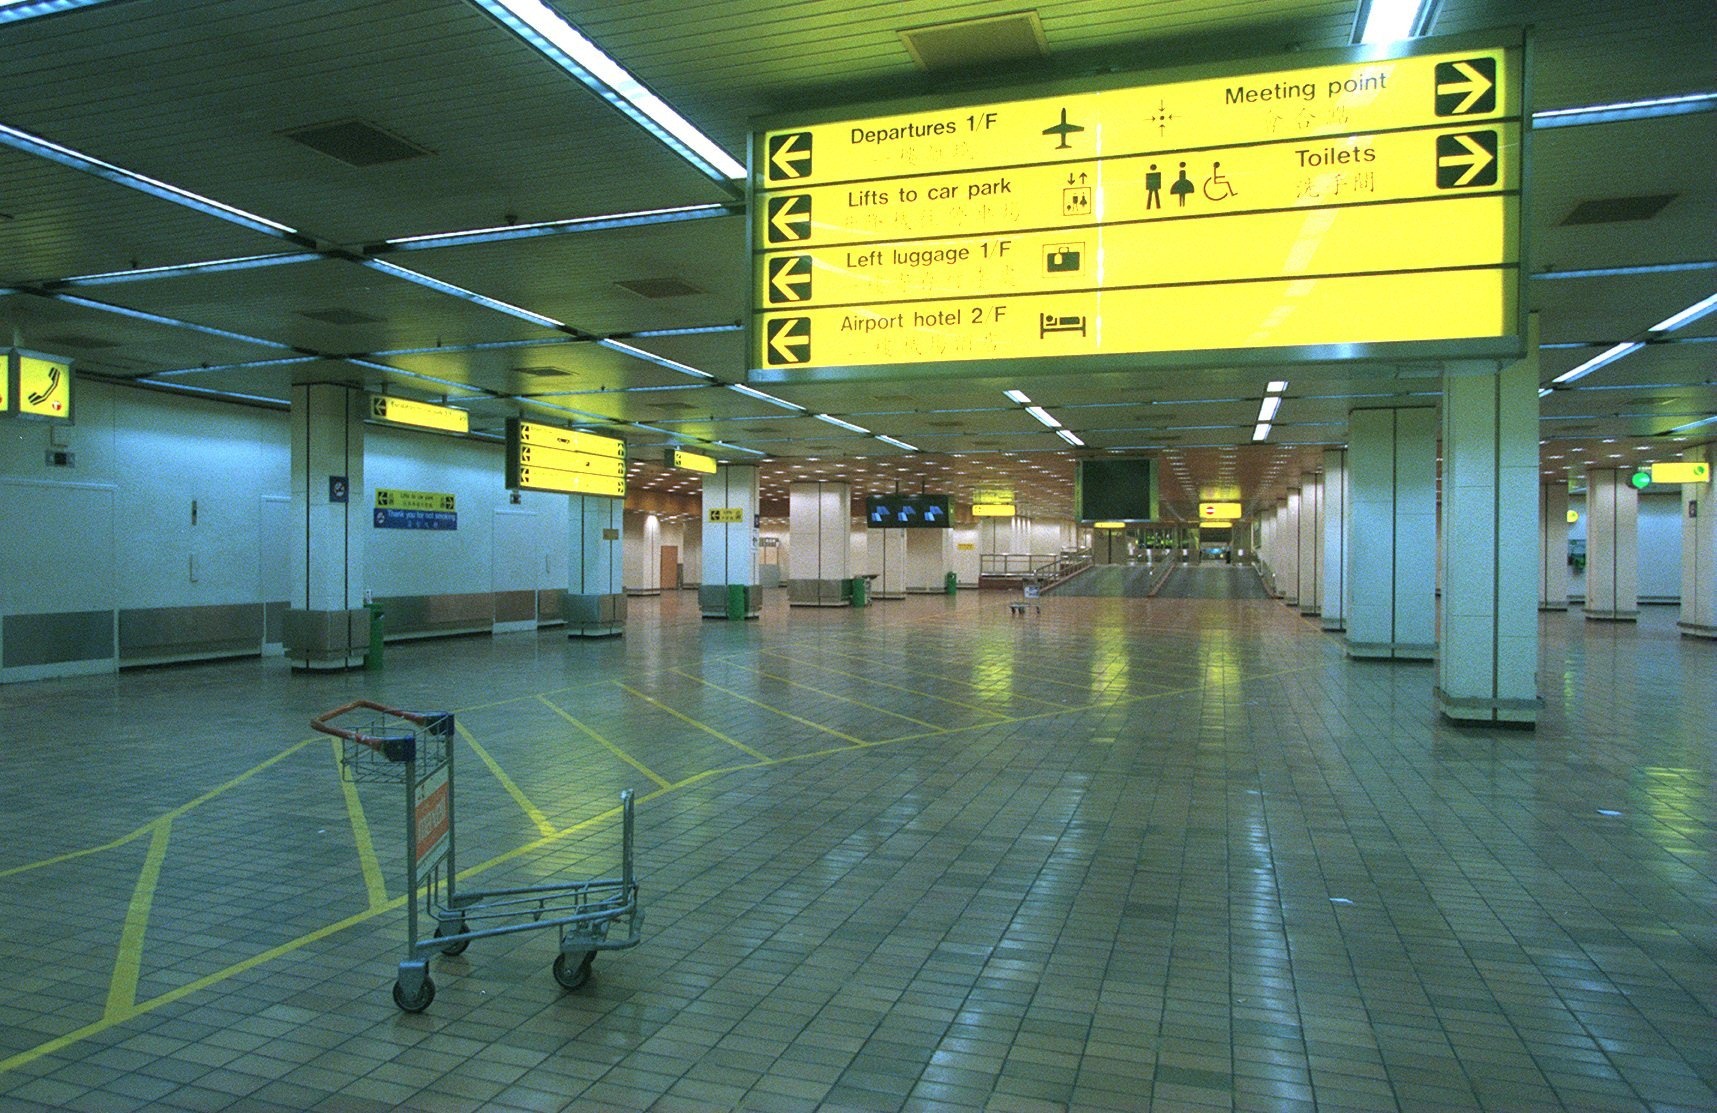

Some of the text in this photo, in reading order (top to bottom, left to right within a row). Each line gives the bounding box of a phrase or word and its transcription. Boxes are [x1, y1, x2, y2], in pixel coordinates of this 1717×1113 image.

[1225, 72, 1387, 106] Meeting point
[851, 112, 998, 145] Departures 1/F
[1295, 146, 1376, 168] Toilets
[848, 177, 1012, 207] Lifts to car park
[847, 240, 1012, 268] Left luggage 1/F
[840, 305, 1007, 333] Airport hotel 2/F
[406, 511, 416, 519] you
